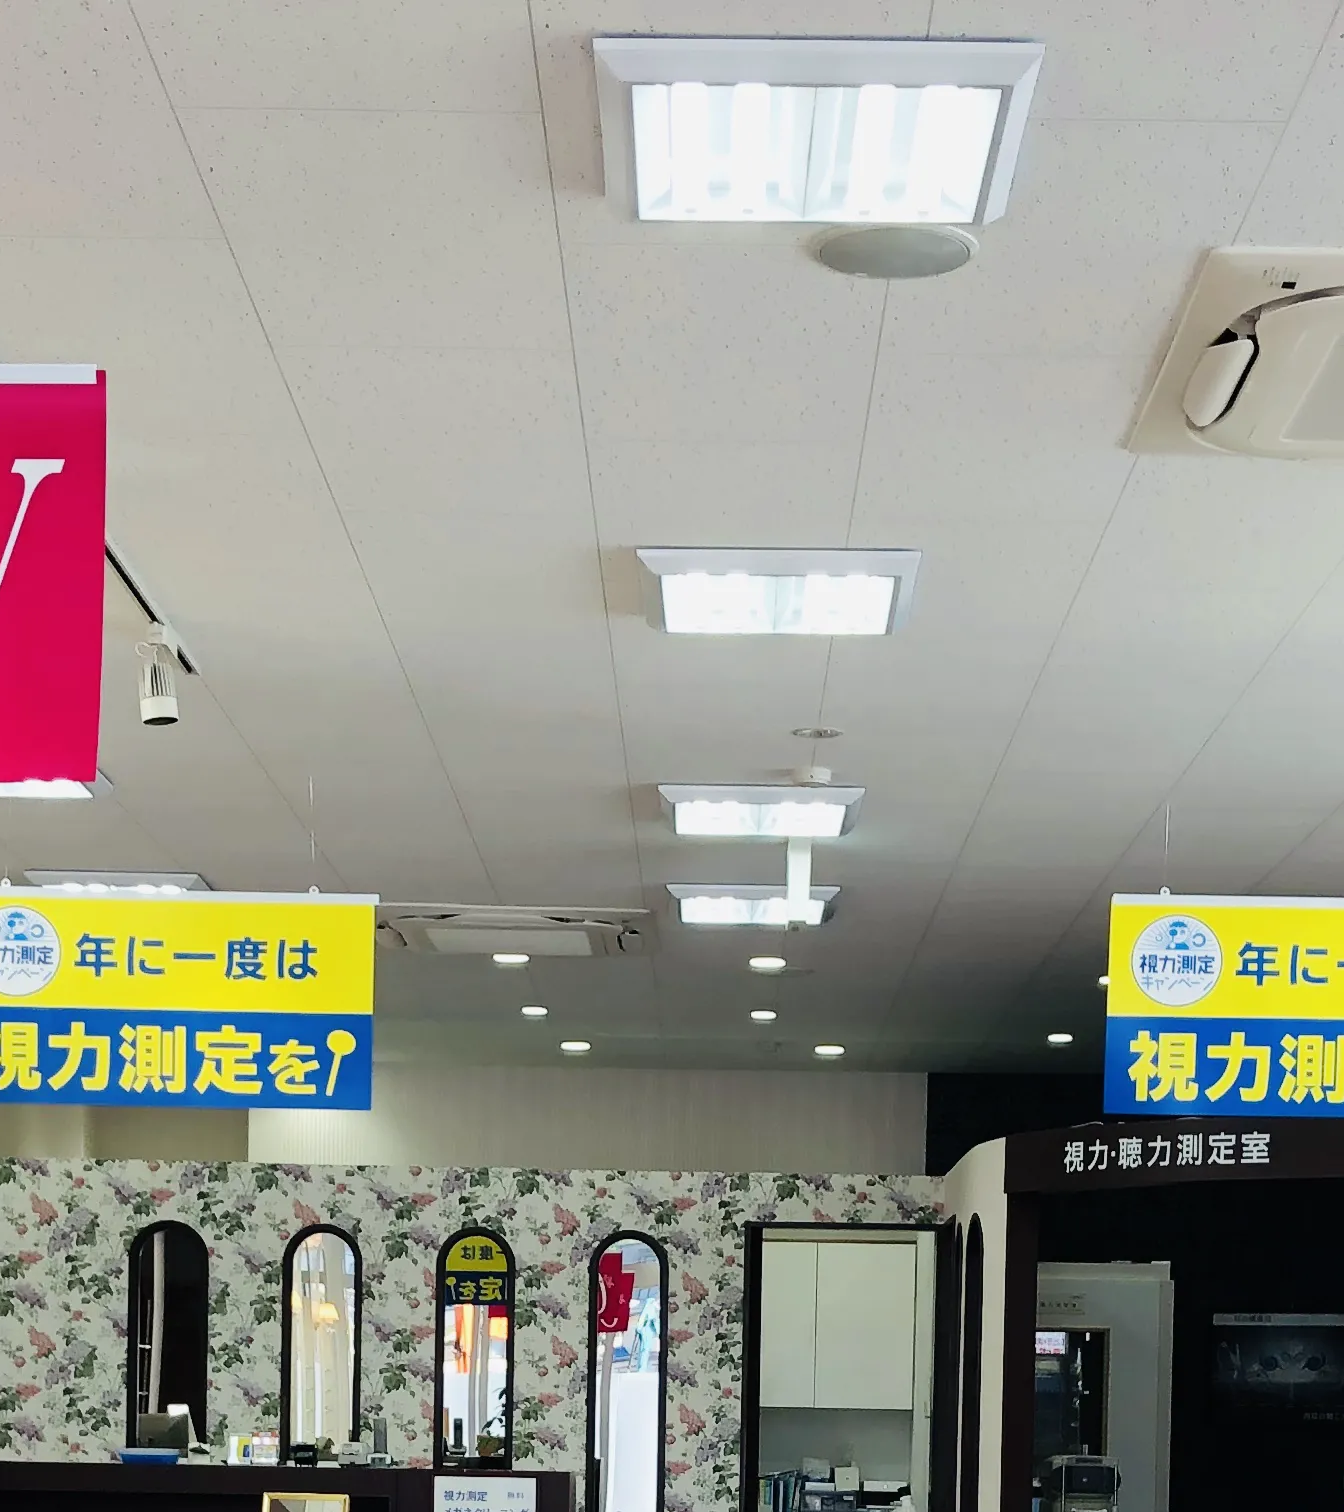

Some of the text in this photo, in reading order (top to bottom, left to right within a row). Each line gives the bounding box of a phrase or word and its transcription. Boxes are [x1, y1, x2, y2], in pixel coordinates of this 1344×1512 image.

[74, 933, 319, 980] 年に一度は
[1139, 953, 1216, 975] 視力測定
[1140, 974, 1214, 992] キャンペーン
[1063, 1132, 1271, 1173] 視力・聴力測定室
[444, 1490, 488, 1501] 視力測定
